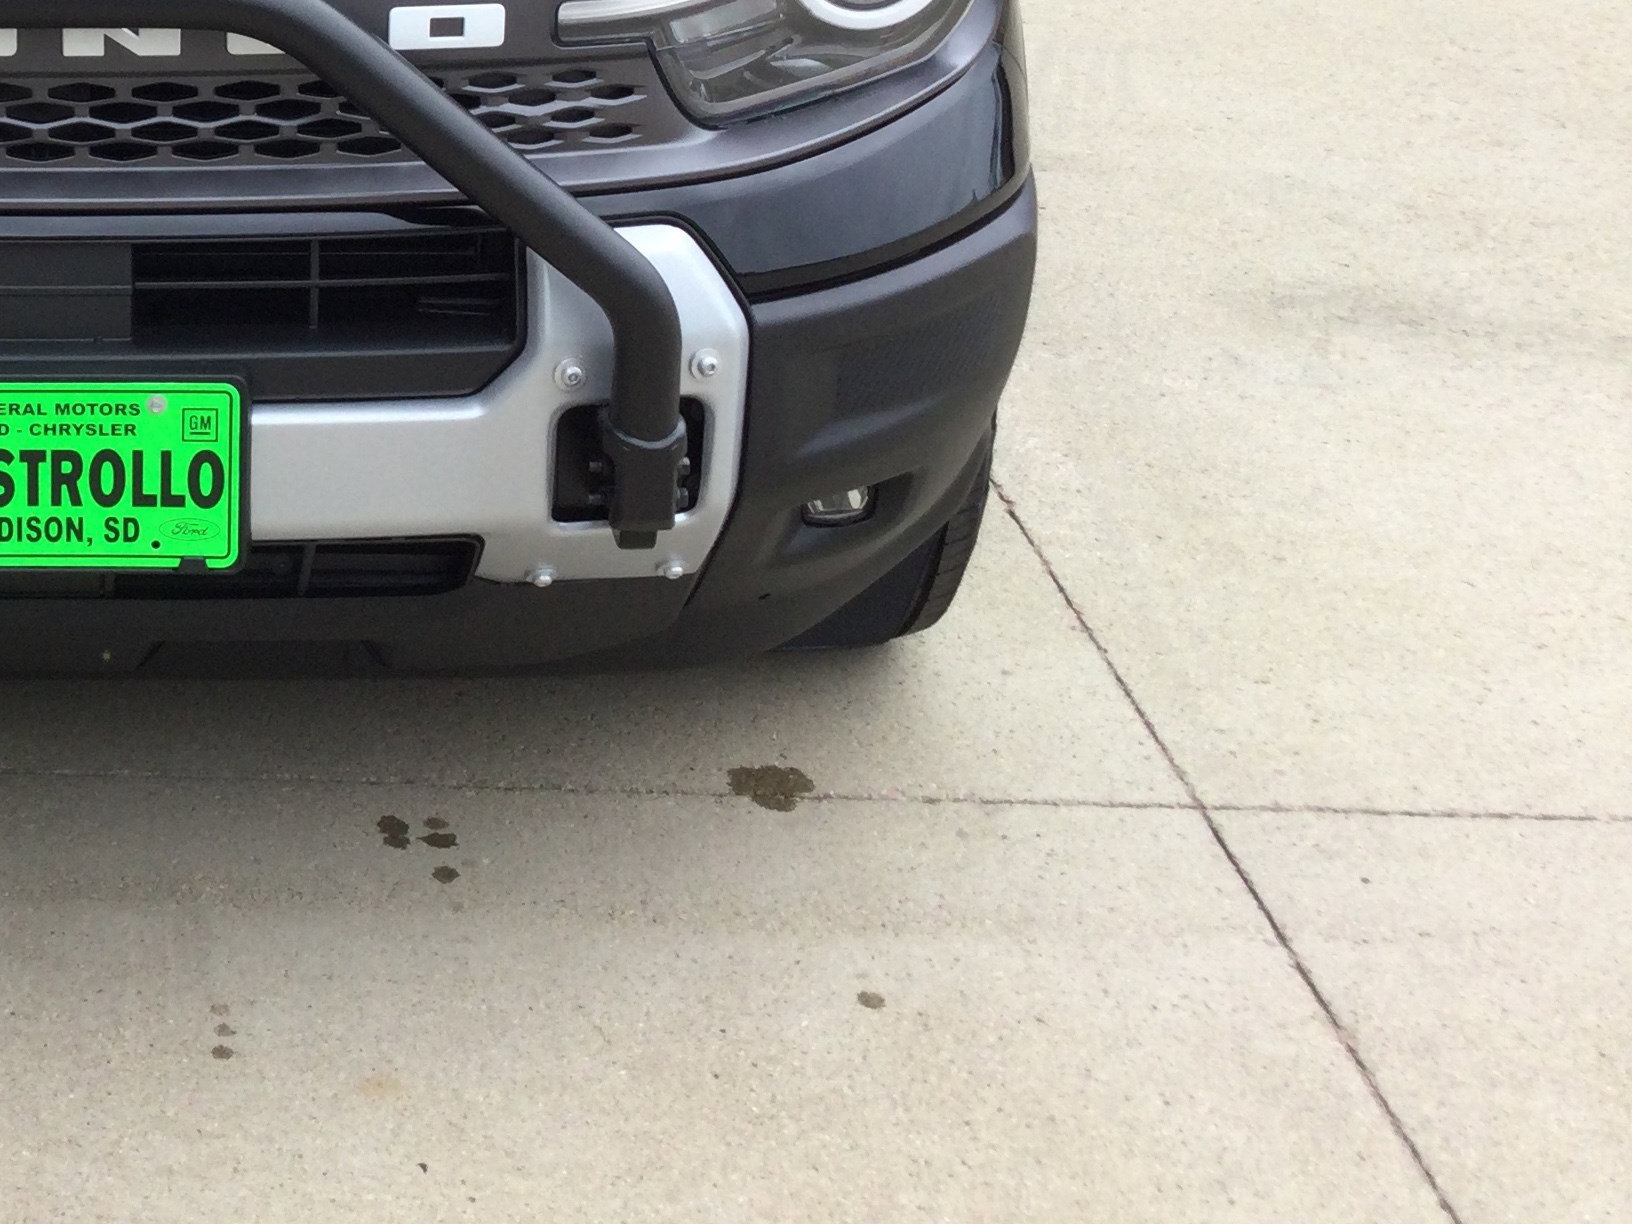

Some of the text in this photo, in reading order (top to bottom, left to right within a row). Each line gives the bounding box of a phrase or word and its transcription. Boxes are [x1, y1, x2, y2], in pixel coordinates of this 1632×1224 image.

[54, 402, 141, 417] MOTORS
[29, 423, 138, 437] CHRYSLER
[188, 413, 213, 431] GM
[103, 516, 140, 543] SD
